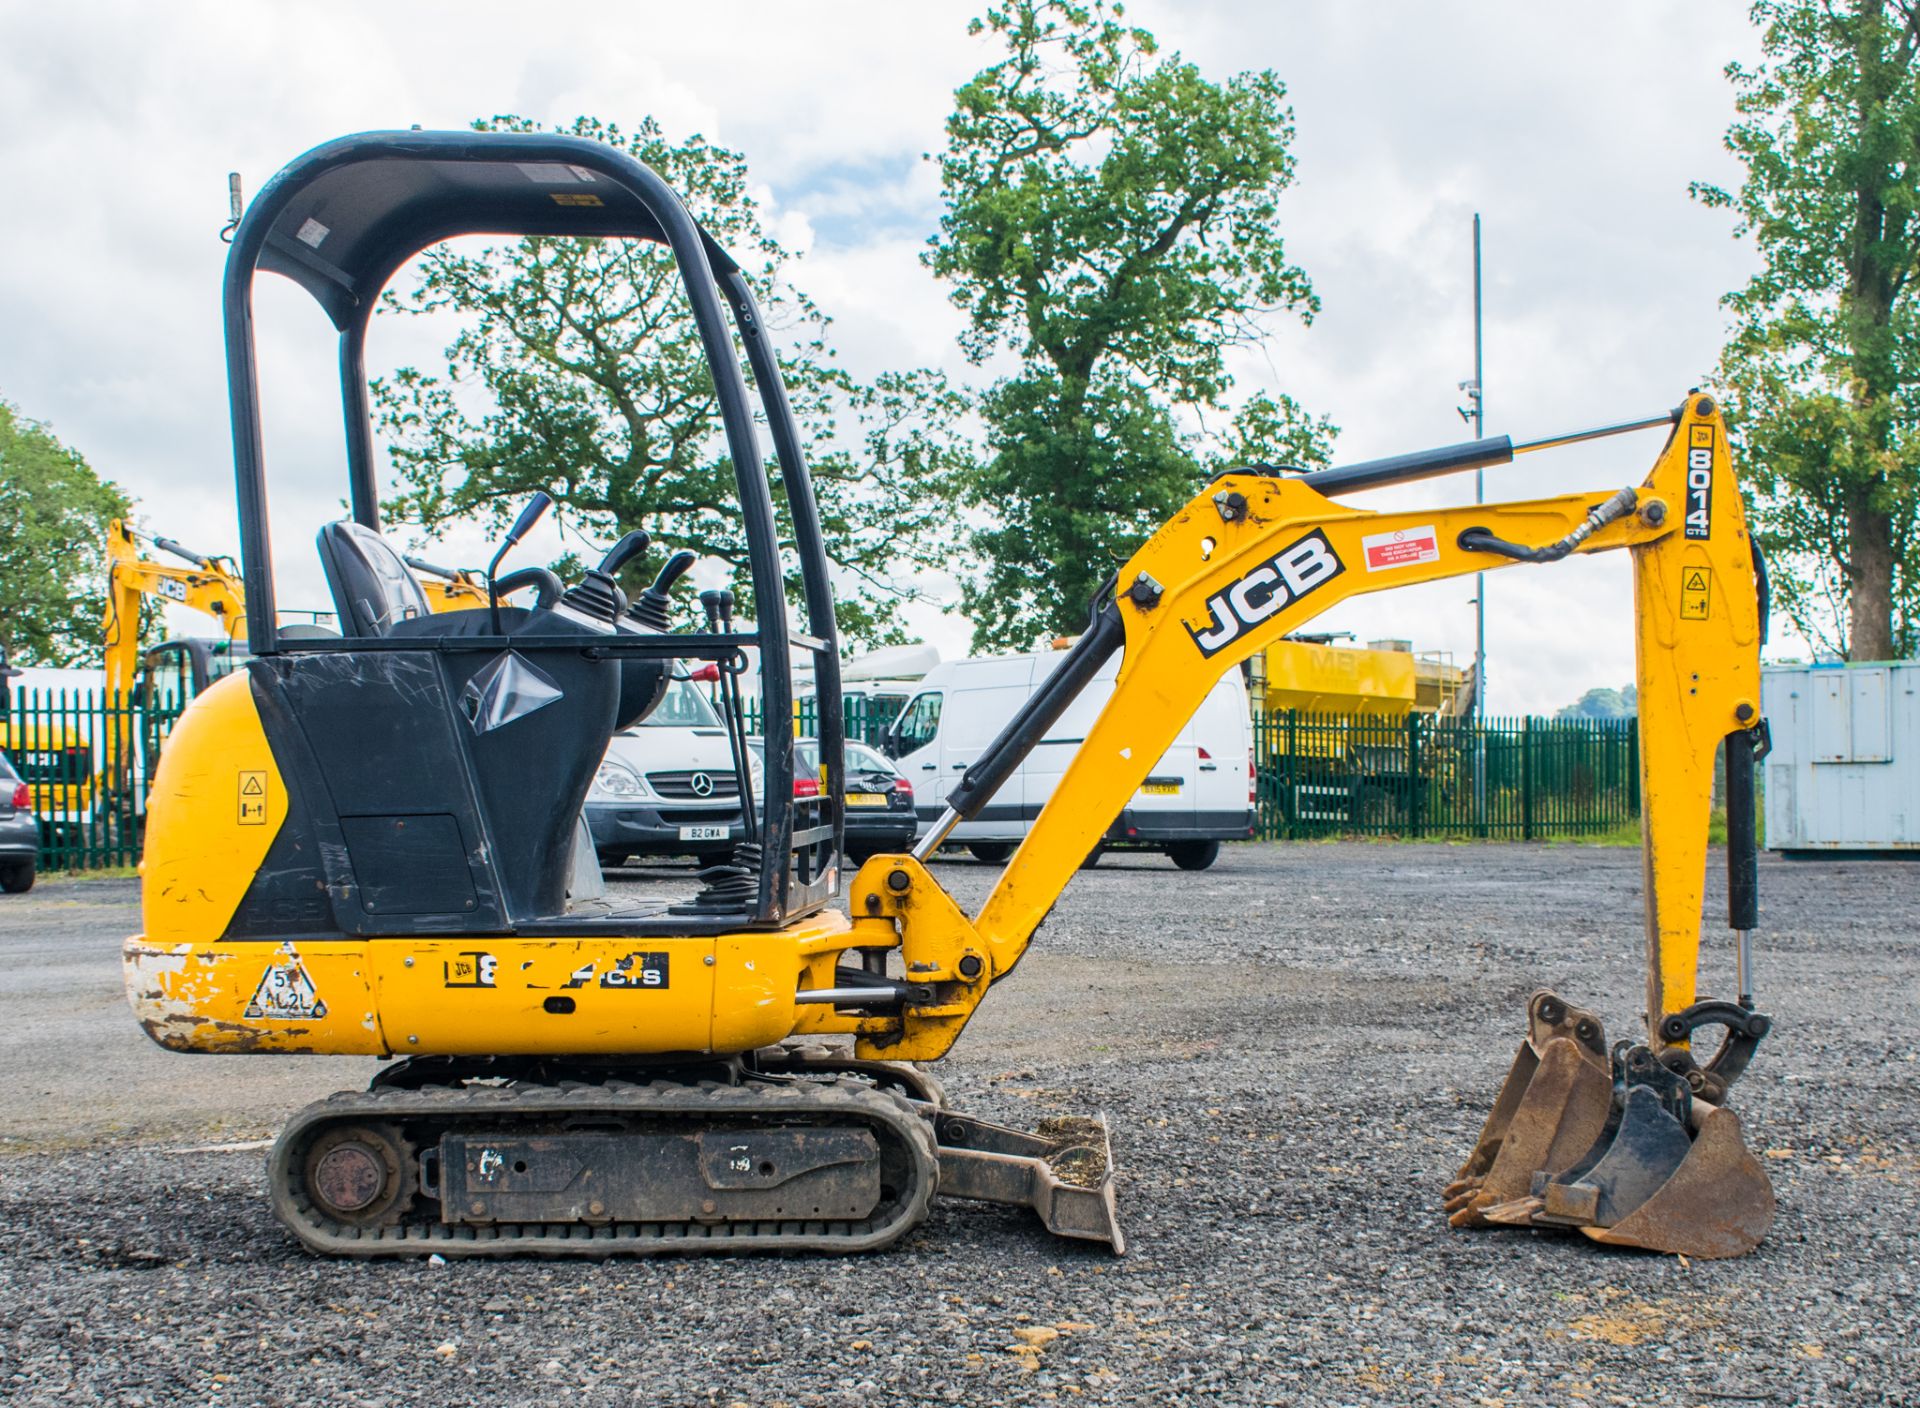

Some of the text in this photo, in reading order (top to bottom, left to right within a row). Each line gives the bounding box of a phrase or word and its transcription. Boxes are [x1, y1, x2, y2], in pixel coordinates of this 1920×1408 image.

[1686, 449, 1712, 528] 8014
[157, 576, 187, 600] JCB
[1197, 537, 1338, 651] JCB
[691, 828, 721, 838] B2 GWA
[455, 961, 472, 976] JCB
